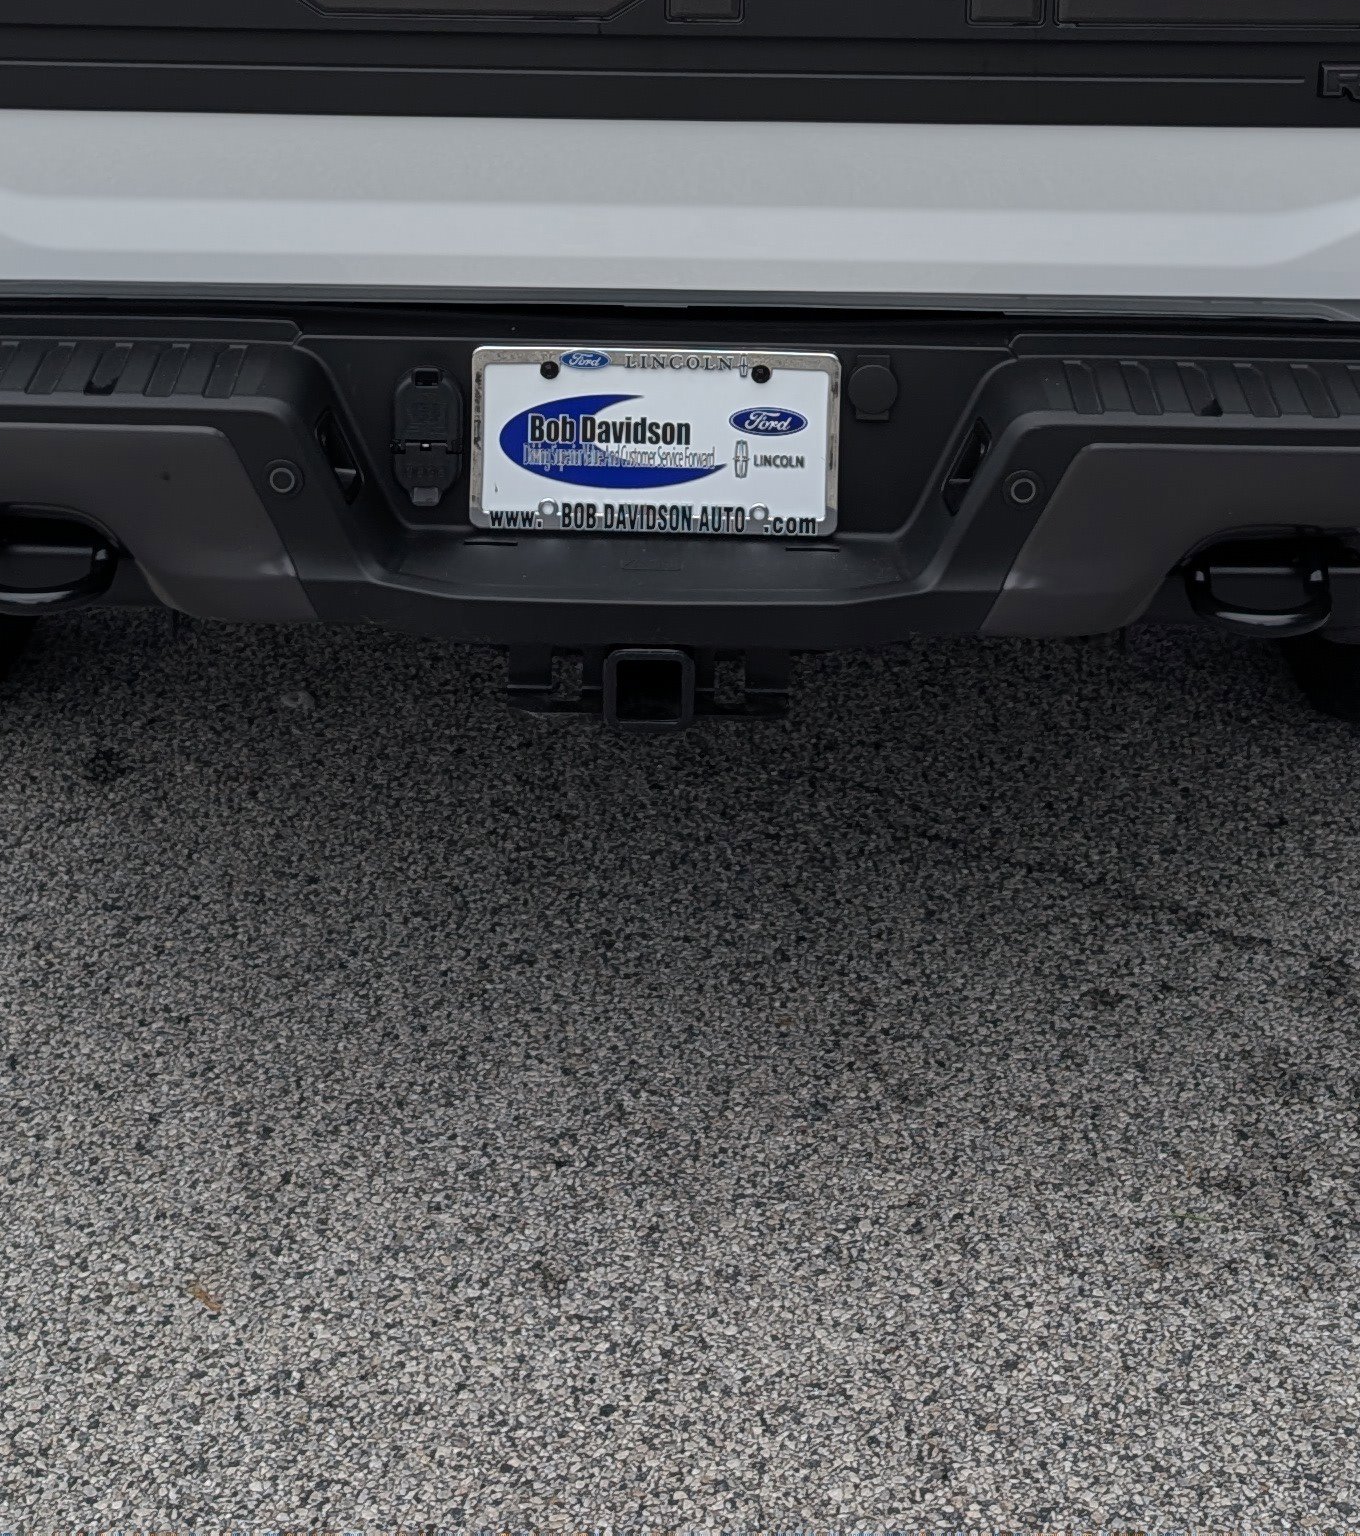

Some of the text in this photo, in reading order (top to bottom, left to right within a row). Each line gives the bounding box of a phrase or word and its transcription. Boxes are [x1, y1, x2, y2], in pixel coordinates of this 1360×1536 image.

[566, 351, 606, 368] Ford
[624, 353, 734, 371] LINCOLN
[529, 413, 690, 446] Bob Davidson
[741, 409, 795, 433] Ford
[621, 445, 656, 468] Customer
[657, 445, 683, 469] Service
[684, 446, 716, 470] Forward
[753, 454, 805, 468] LINCOLN
[490, 502, 818, 535] www. BOB DAVIDSON AUTO .com
